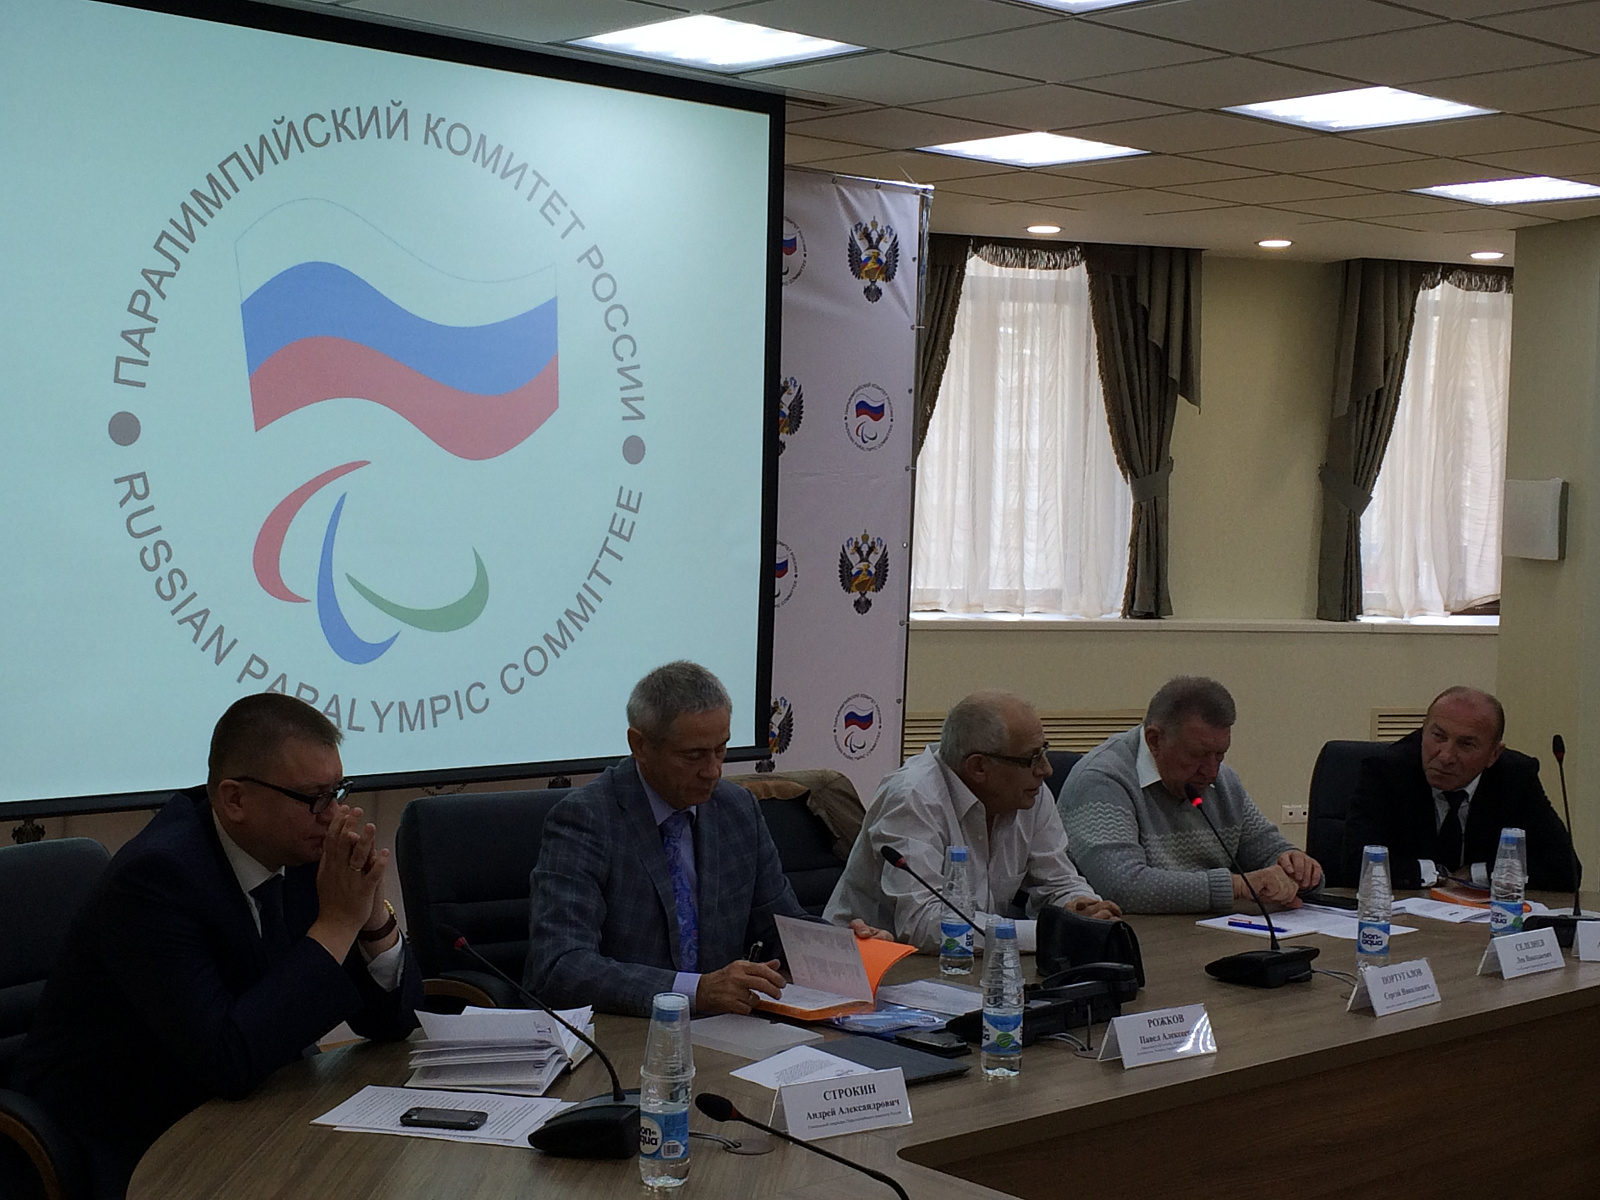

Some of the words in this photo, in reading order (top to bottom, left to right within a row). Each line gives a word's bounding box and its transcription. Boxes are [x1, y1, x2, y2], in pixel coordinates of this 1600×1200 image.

[113, 99, 409, 388] ПАРАЛИМПИЙСКИЙ
[423, 113, 586, 240] КОМИТЕТ
[576, 244, 646, 422] РОССИИ
[113, 471, 239, 666] RUSSIAN
[500, 485, 643, 695] COMMITTEE
[1361, 939, 1383, 947] aqua
[1147, 1014, 1185, 1028] РОЖКОВ
[1139, 1034, 1161, 1044] Павел
[823, 1084, 877, 1101] СТРОКИН
[806, 1107, 837, 1121] Андрей
[838, 1099, 900, 1116] Александрович
